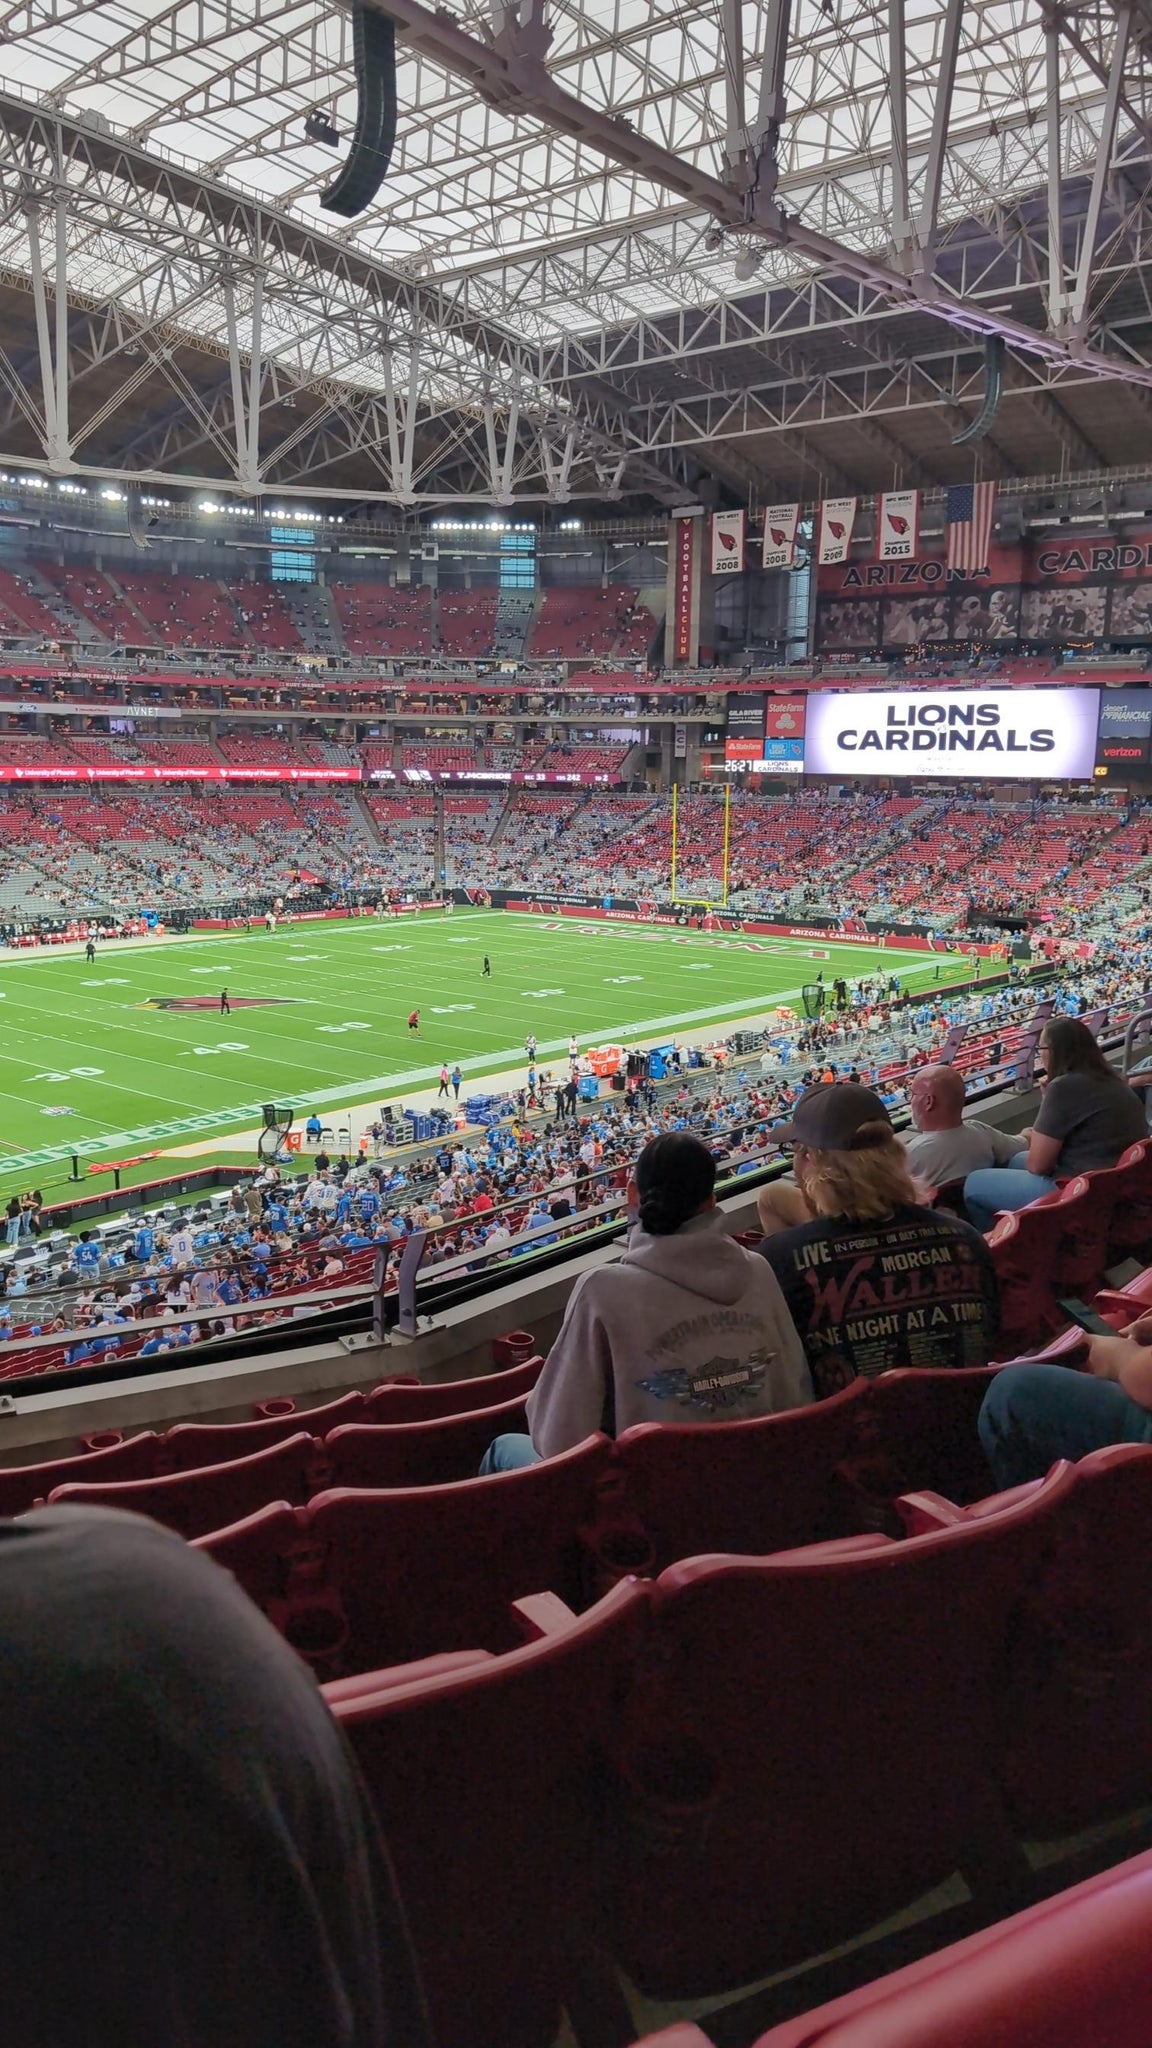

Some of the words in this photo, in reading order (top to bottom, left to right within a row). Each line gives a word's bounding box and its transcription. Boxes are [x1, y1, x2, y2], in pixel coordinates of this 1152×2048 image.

[824, 550, 843, 561] 2009
[884, 545, 910, 556] 2015
[766, 555, 787, 565] 2008
[716, 561, 739, 571] 2008
[682, 533, 690, 612] FOOTBALL
[680, 615, 688, 654] CLUB
[887, 704, 1000, 726] LIONS
[837, 729, 1055, 752] CARDINALS
[1104, 747, 1142, 756] verizon
[725, 760, 752, 772] 26:27
[606, 912, 635, 920] ARIZONA
[637, 915, 675, 923] CARINALS
[739, 912, 774, 920] CARDINALS
[790, 929, 826, 938] ARIZONA
[829, 932, 876, 942] CARDINALS
[315, 1022, 373, 1033] 50
[193, 1042, 250, 1054] 40
[34, 1067, 105, 1082] 30
[127, 1098, 312, 1142] INERCEPT
[290, 1135, 299, 1144] G
[361, 1200, 374, 1211] 20
[179, 1241, 186, 1252] 0
[82, 1252, 92, 1261] 54
[793, 1240, 832, 1271] LIVE
[882, 1247, 952, 1273] MORGAN
[846, 1314, 899, 1341] NIGHT
[906, 1309, 926, 1330] AT
[931, 1307, 949, 1325] A
[951, 1303, 984, 1322] TIME
